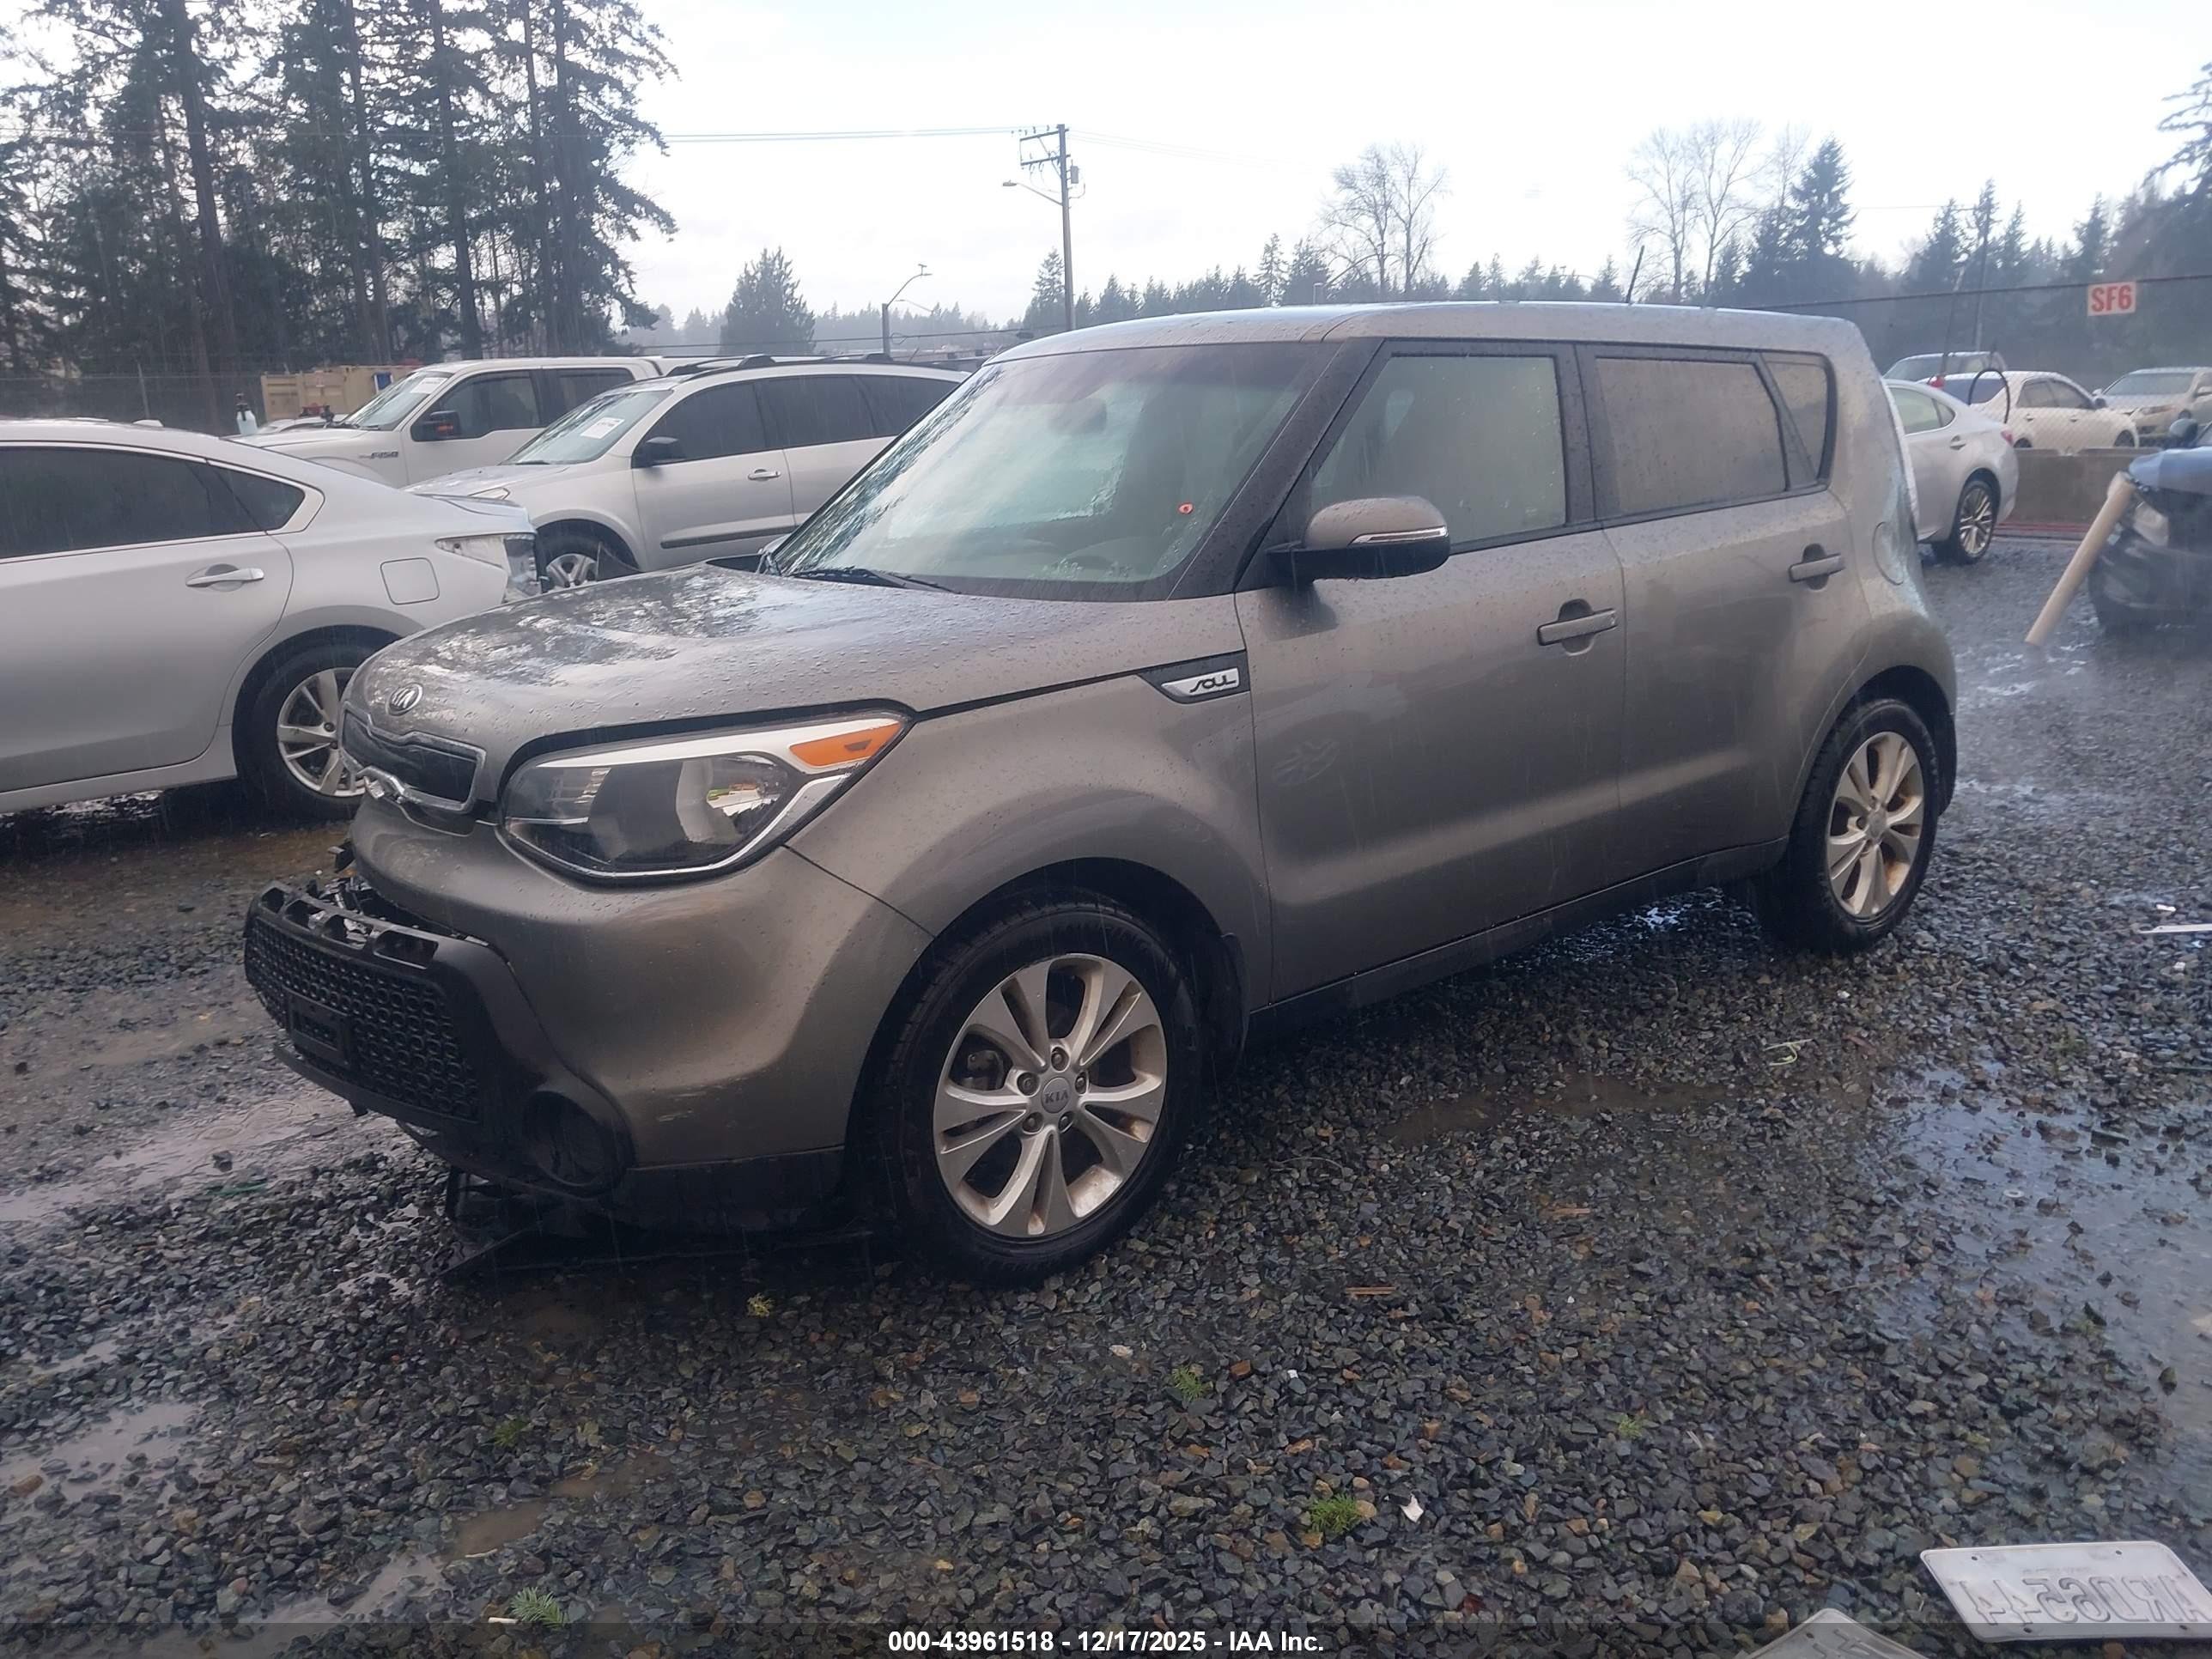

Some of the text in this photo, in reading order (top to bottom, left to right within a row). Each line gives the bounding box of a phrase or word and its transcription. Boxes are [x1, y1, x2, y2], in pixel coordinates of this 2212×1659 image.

[2091, 284, 2132, 313] SF6
[1188, 674, 1237, 694] SOUL
[1044, 1089, 1069, 1104] KIA
